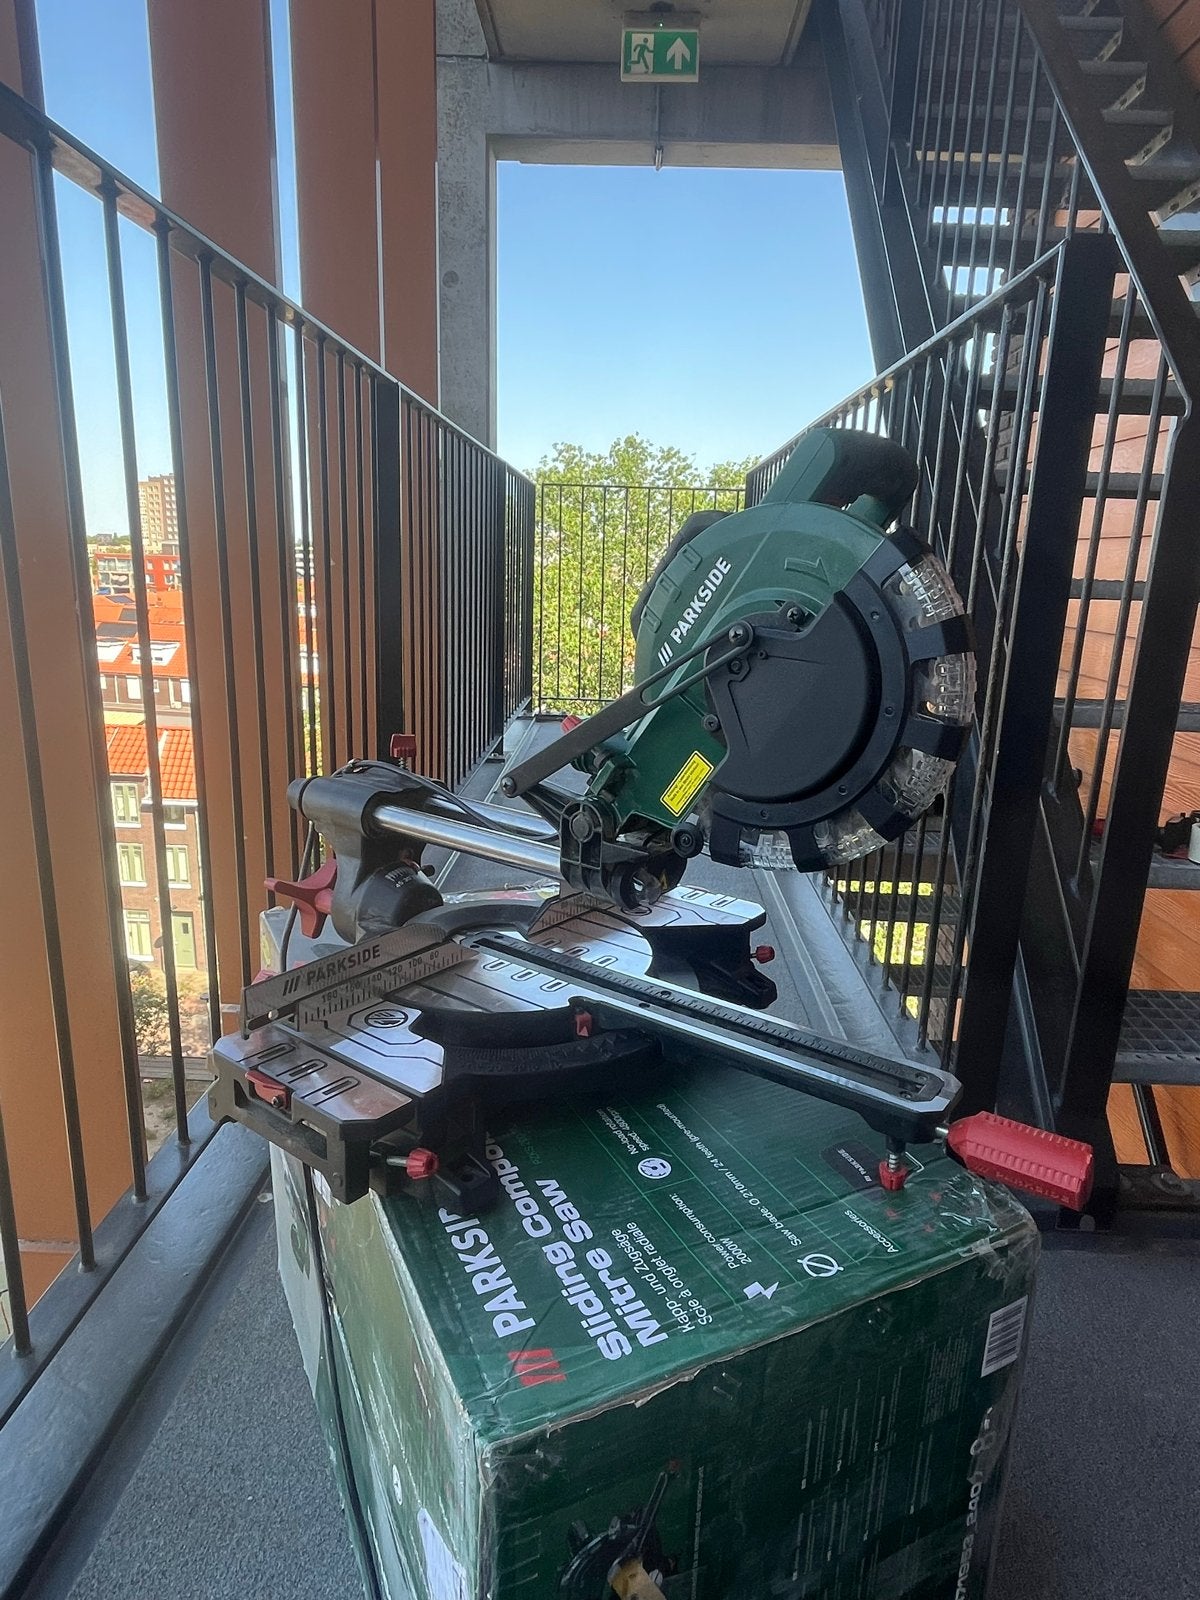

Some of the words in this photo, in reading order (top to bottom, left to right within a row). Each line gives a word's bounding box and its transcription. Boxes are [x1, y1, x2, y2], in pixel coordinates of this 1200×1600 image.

[670, 556, 732, 644] PARKSIDE
[306, 944, 381, 986] PARKSIDE
[614, 1129, 639, 1155] No-load
[695, 1140, 714, 1159] teeth
[709, 1157, 724, 1168] 24
[837, 1148, 867, 1175] PARKSIDE
[724, 1171, 754, 1198] 210mm
[535, 1179, 594, 1243] Saw
[669, 1192, 716, 1244] consumption:
[627, 1221, 657, 1258] radiale
[781, 1228, 802, 1247] Saw
[844, 1209, 899, 1253] Accessories
[611, 1229, 647, 1274] Zugsäge
[713, 1242, 740, 1269] Power
[720, 1238, 752, 1265] 2000W
[642, 1274, 667, 1296] und
[655, 1255, 684, 1289] onglet
[542, 1240, 633, 1361] Sliding
[586, 1248, 669, 1348] Mitre
[680, 1288, 692, 1299] à
[665, 1297, 696, 1333] Kapp-
[688, 1299, 713, 1326] Scie
